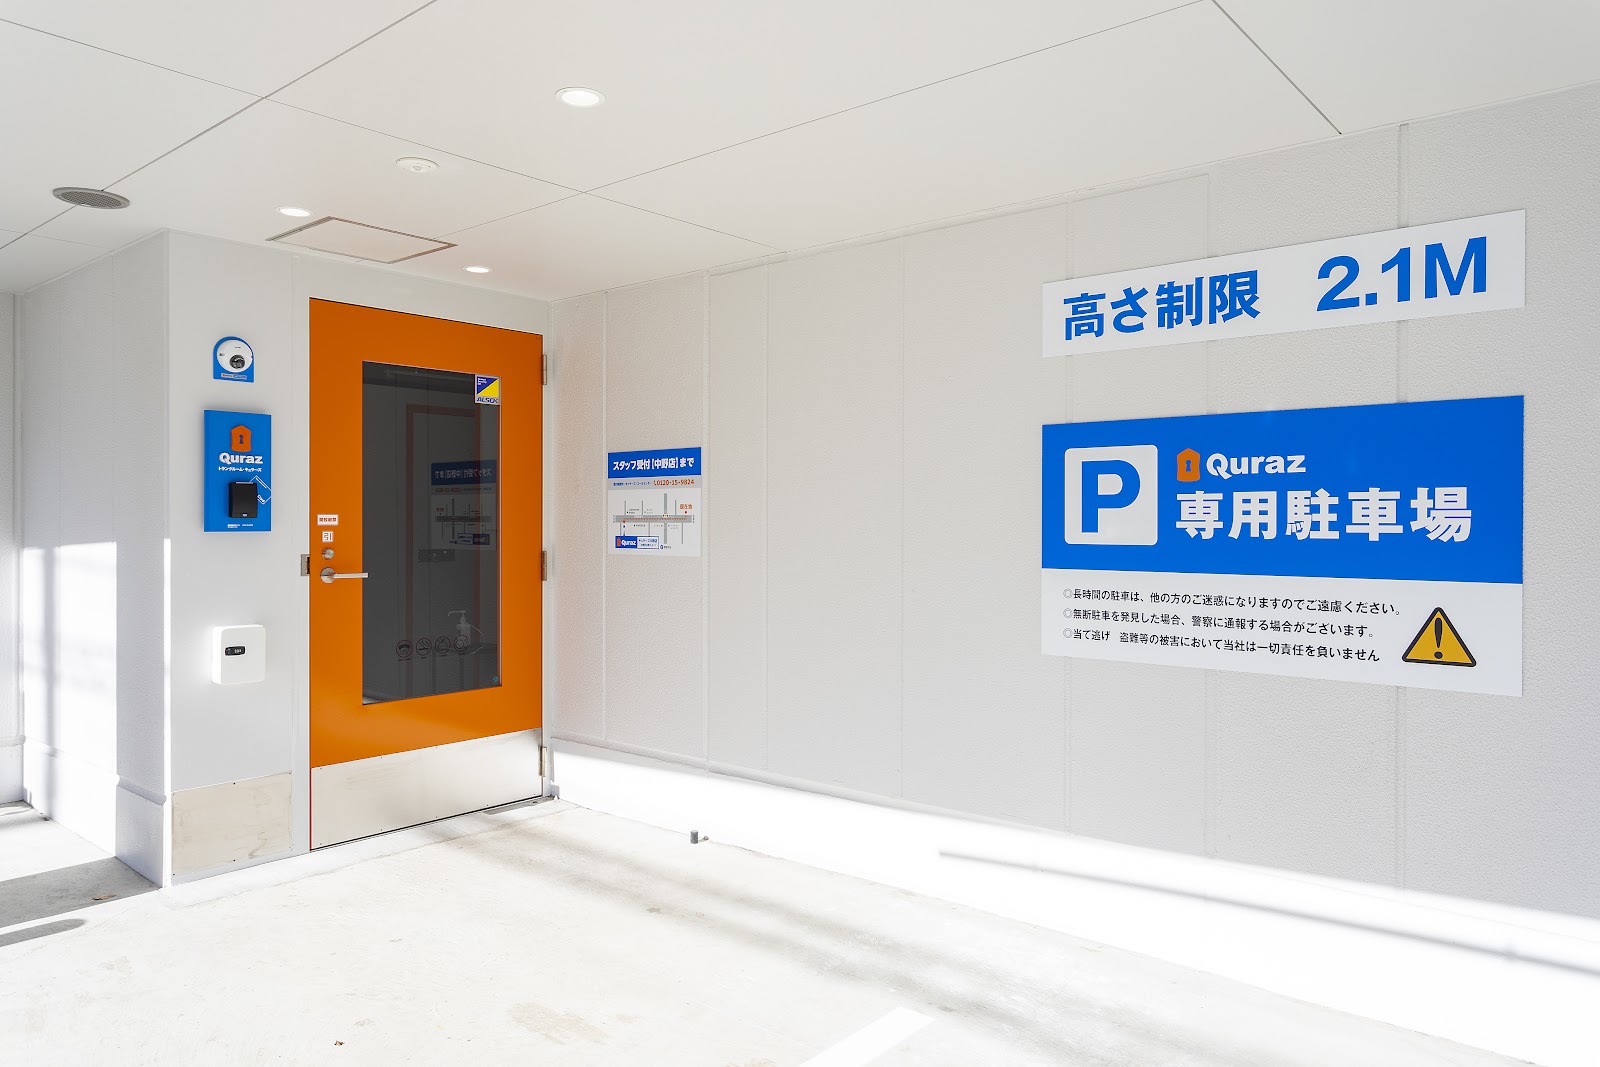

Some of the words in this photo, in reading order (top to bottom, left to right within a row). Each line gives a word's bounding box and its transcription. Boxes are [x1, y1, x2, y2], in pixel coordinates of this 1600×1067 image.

[1063, 269, 1261, 341] 高さ制限
[1316, 236, 1487, 312] 2.1M
[219, 452, 263, 464] Quraz
[1206, 453, 1307, 480] Quraz
[1081, 459, 1141, 533] P
[1175, 486, 1473, 543] 専用駐車場
